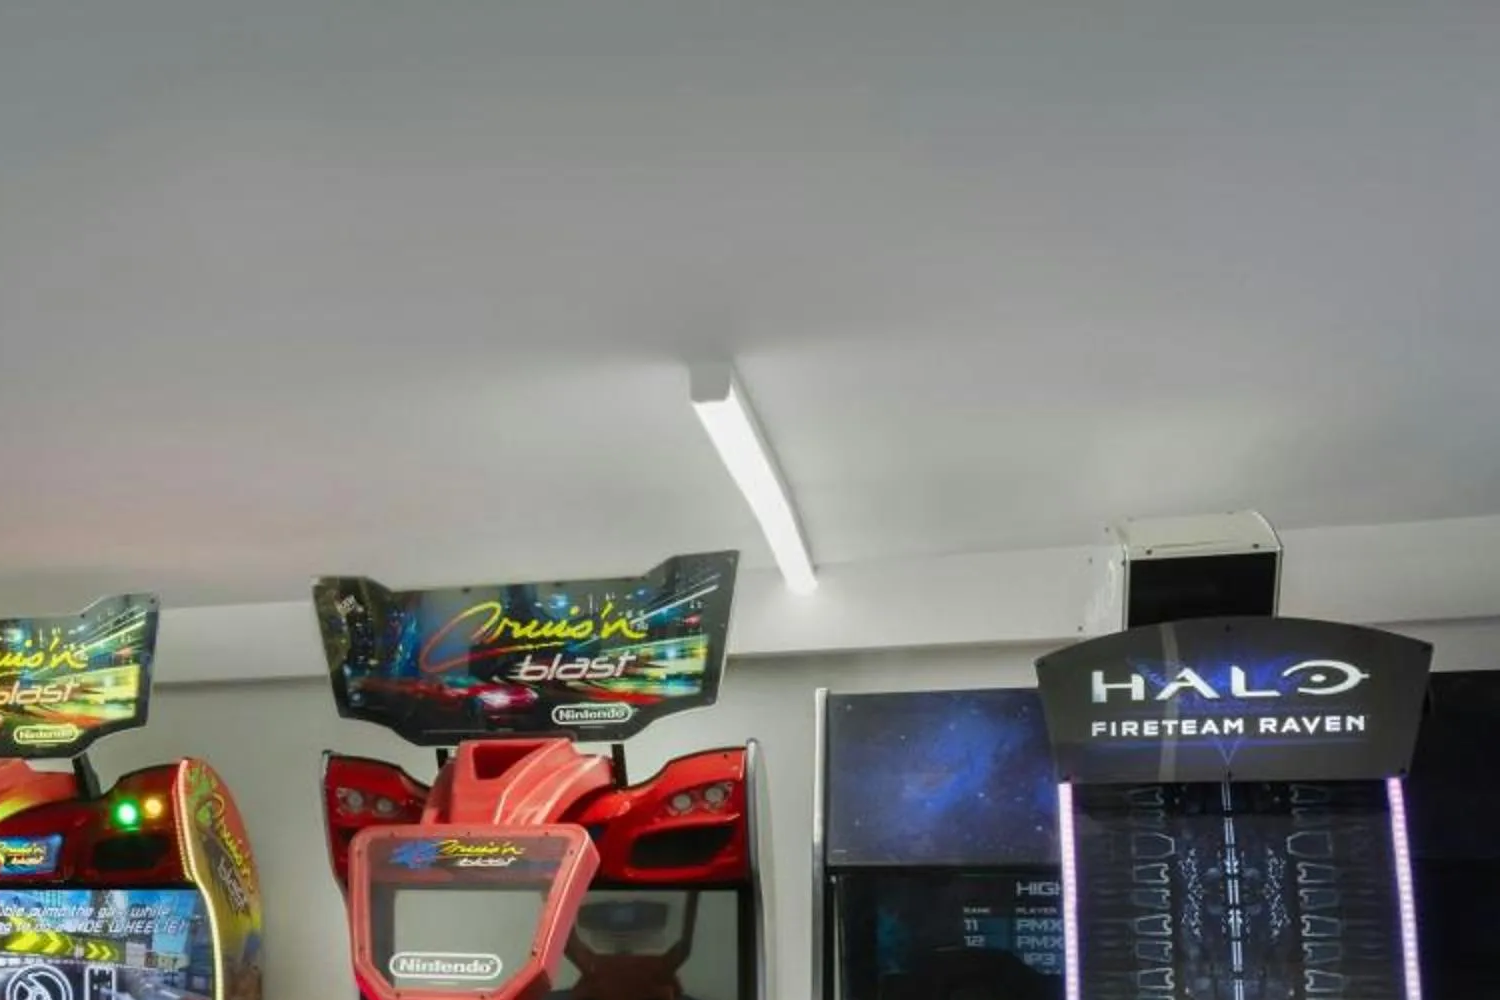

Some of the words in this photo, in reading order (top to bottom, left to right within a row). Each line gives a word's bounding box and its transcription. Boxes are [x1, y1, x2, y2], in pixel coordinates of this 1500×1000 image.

[510, 652, 637, 680] blast
[1091, 659, 1370, 703] HALO
[557, 708, 626, 722] Nintendo
[1091, 717, 1244, 737] FIRETEAM
[1258, 715, 1365, 735] RAVEN
[399, 958, 492, 974] Nintendo
